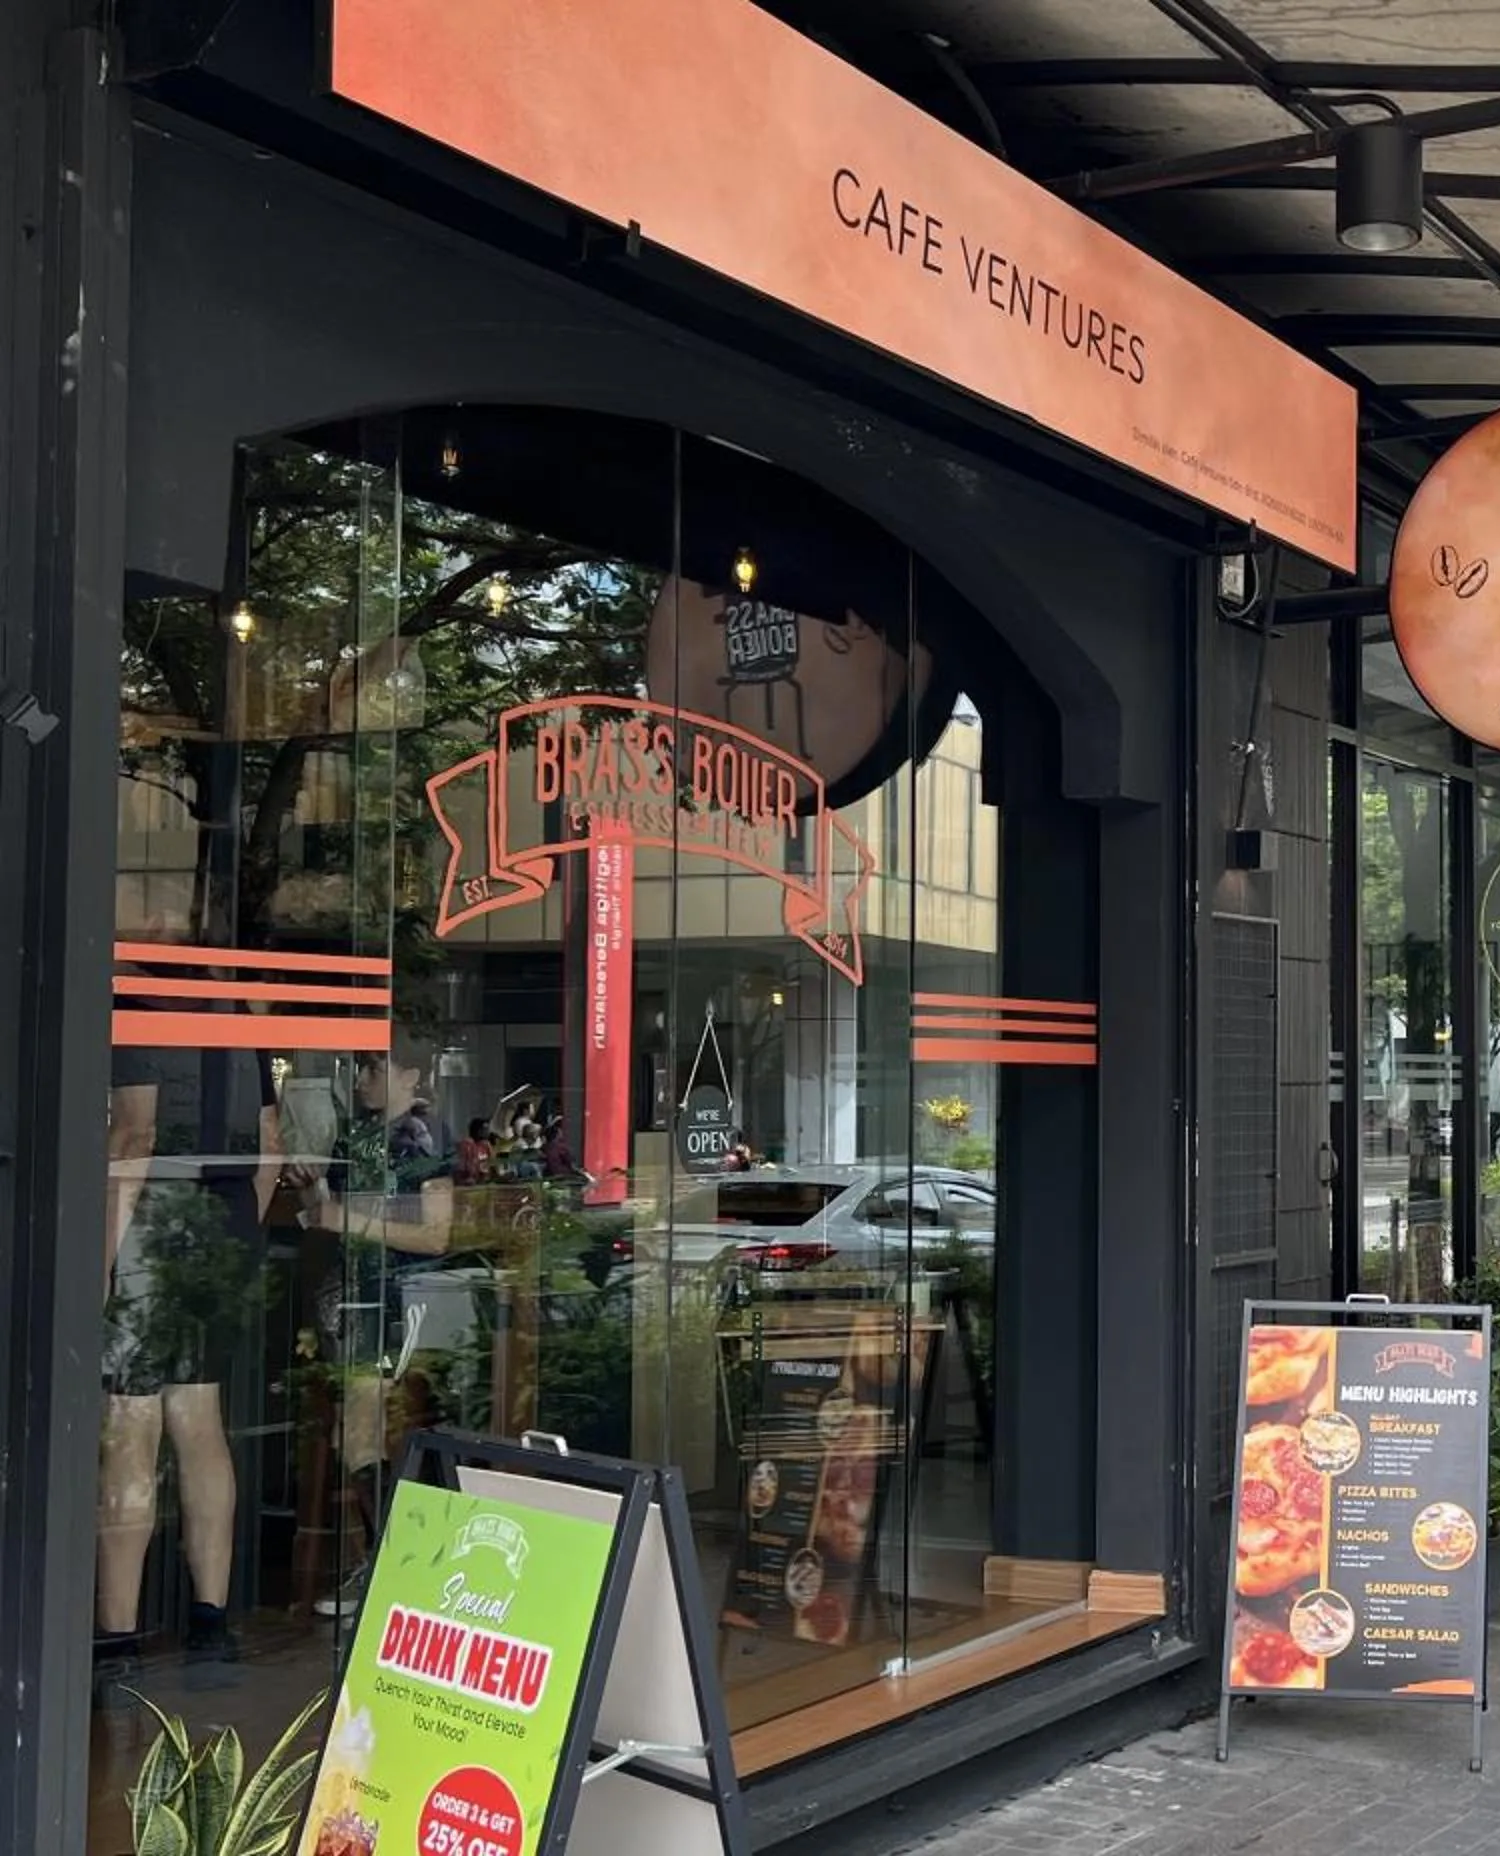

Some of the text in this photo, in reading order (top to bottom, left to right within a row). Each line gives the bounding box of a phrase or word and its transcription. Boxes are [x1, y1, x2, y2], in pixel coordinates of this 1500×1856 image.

[833, 168, 1145, 384] CAFE VENTURES
[536, 718, 798, 838] BRASS BOILER
[687, 1131, 730, 1153] OPEN
[1341, 1385, 1478, 1406] MENU HIGHLIGHTS
[1368, 1421, 1442, 1436] BREAKFAST
[1338, 1485, 1417, 1498] PIZZA BITES
[1337, 1529, 1389, 1542] NACHOS
[440, 1572, 515, 1624] Special
[1364, 1583, 1450, 1597] SANDWICHES
[1363, 1627, 1460, 1642] CAESAR SALAD
[380, 1609, 550, 1707] DRINK MENU
[374, 1676, 527, 1739] Quench Your Thirst and Elevate
[413, 1712, 436, 1731] Your
[431, 1791, 470, 1821] ORDER
[479, 1806, 489, 1826] &
[489, 1809, 517, 1835] GET
[424, 1819, 466, 1856] 25%
